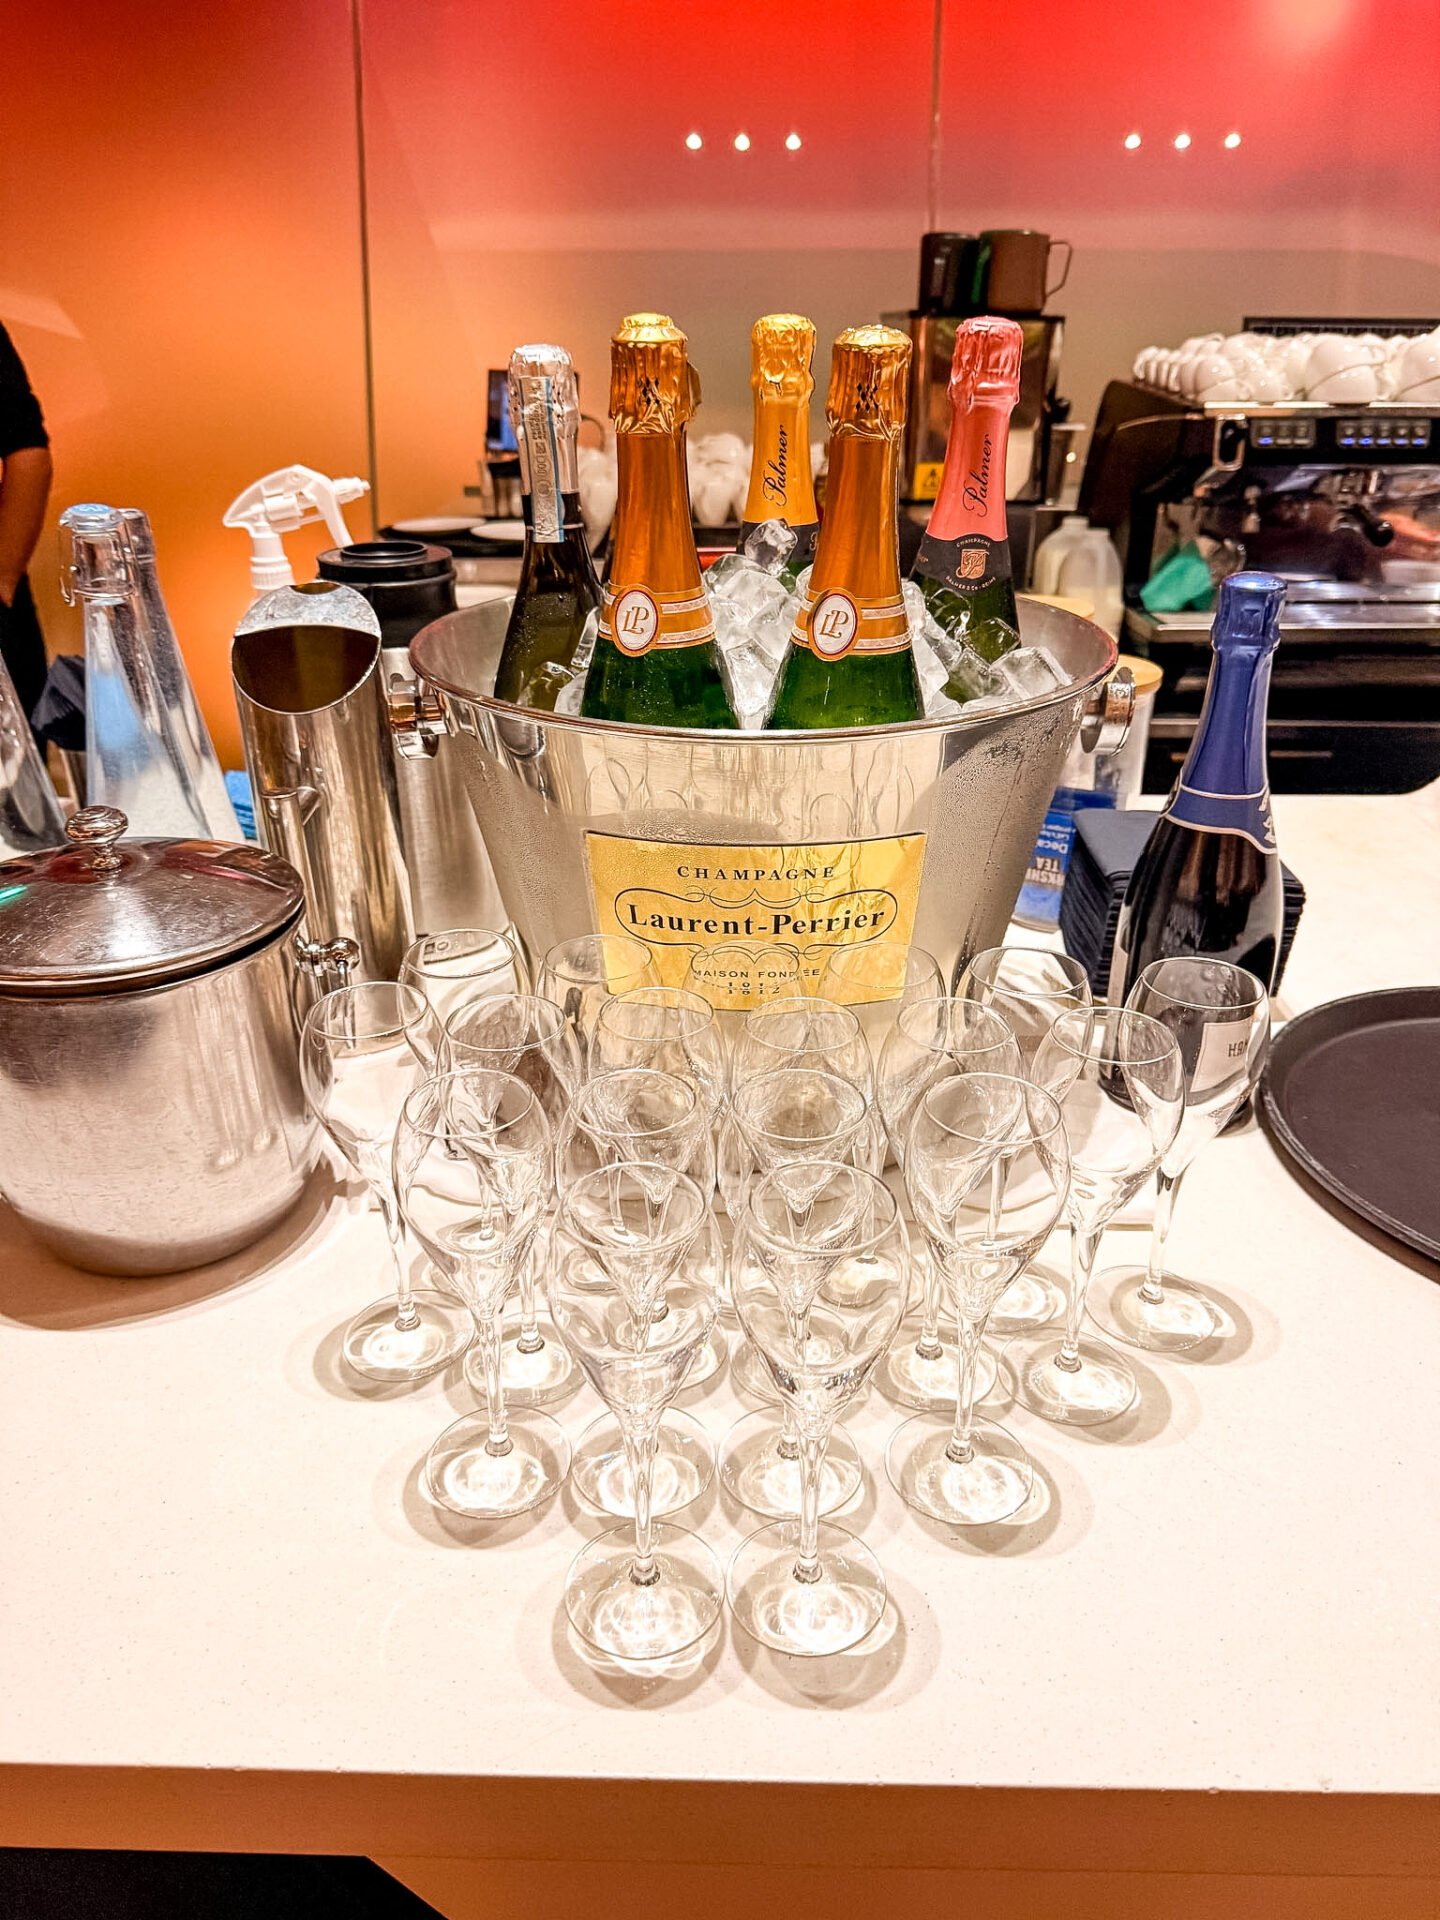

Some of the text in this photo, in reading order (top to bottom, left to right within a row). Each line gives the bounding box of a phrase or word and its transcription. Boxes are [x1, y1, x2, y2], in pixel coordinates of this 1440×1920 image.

[763, 424, 788, 507] Palmer
[962, 433, 992, 518] Palmer
[622, 605, 650, 635] LP
[819, 609, 849, 639] LP
[1035, 839, 1068, 854] Deca
[677, 865, 834, 881] CHAMPAGNE
[1035, 856, 1060, 873] TEA
[626, 902, 885, 936] Laurent-Perrier
